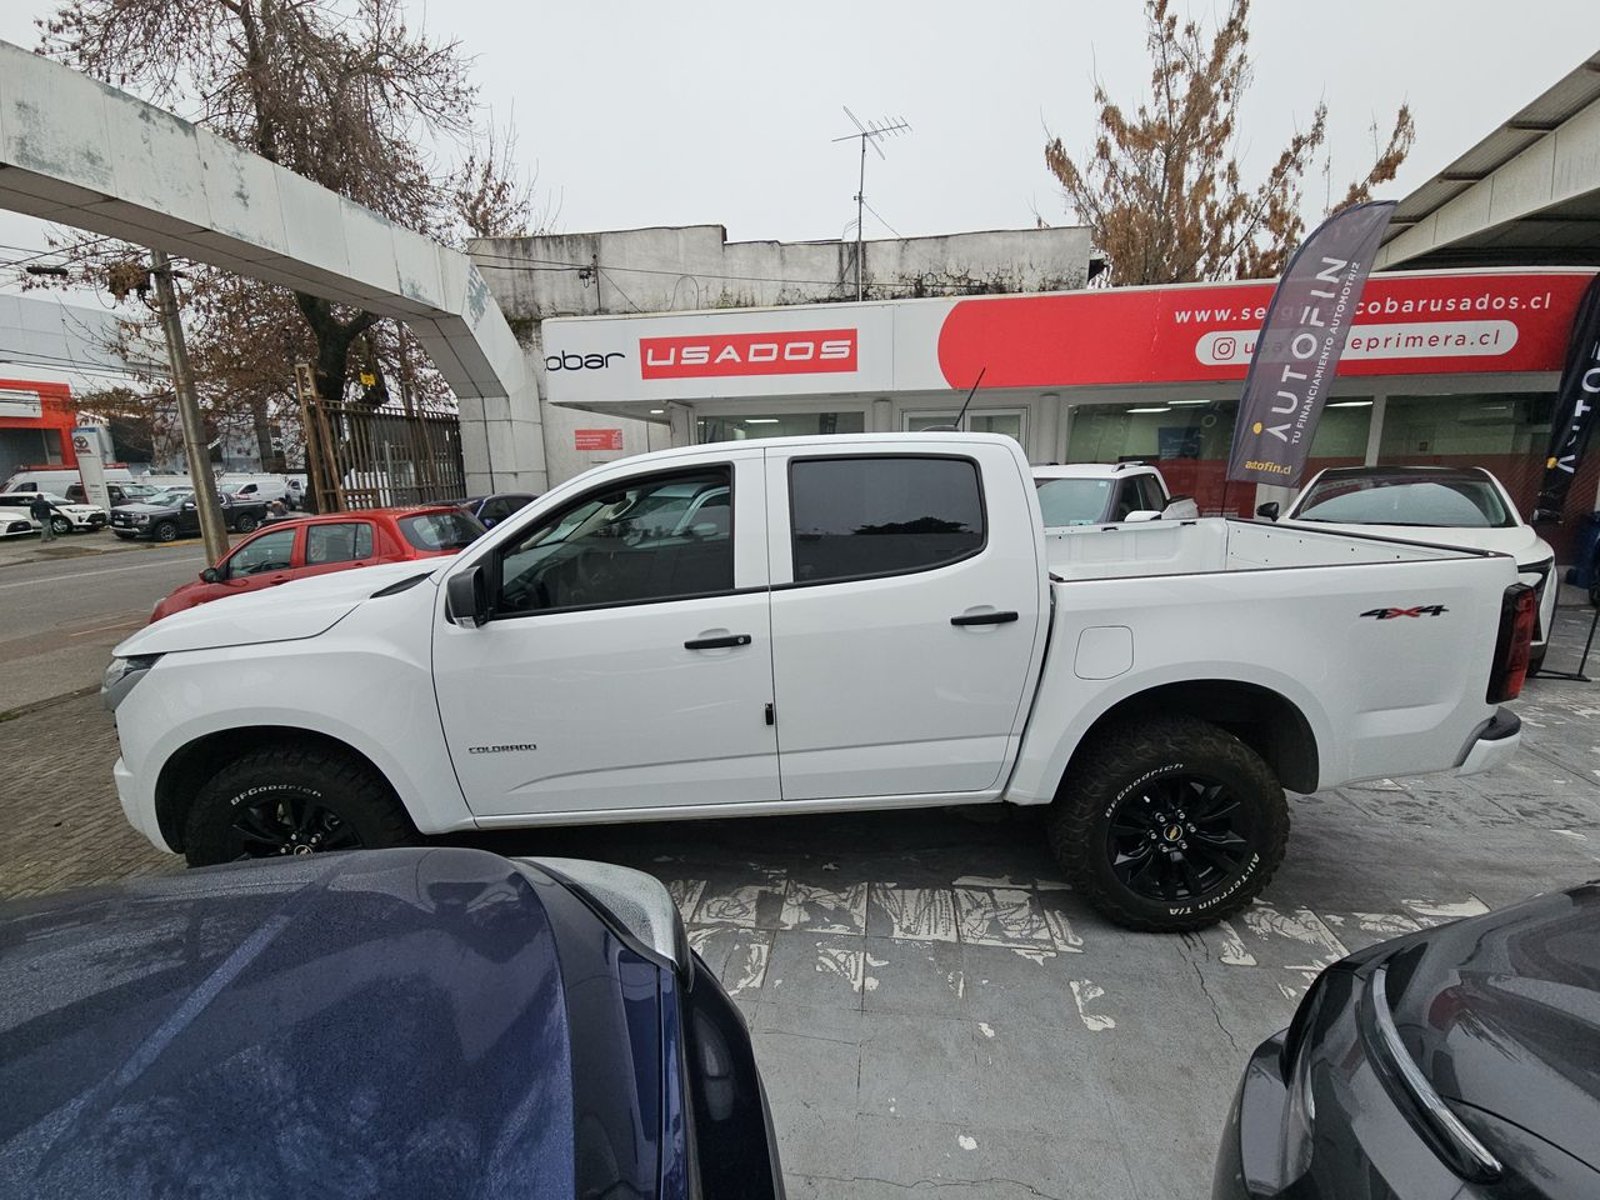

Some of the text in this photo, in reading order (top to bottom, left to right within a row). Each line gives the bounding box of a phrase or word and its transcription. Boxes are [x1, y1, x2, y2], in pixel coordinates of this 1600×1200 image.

[1174, 293, 1552, 323] www.segcobarusados.cl
[544, 340, 852, 372] obar USADOS
[1243, 329, 1501, 355] ueprimera.cl
[1266, 257, 1348, 442] AUTOFIN
[1291, 261, 1361, 444] TU FINANCIAMIENTO AUTOMOTRIZ
[468, 744, 537, 754] COLORADO
[230, 784, 322, 806] BFGoodrich
[1105, 763, 1184, 818] BFGoodrich
[1169, 852, 1260, 915] All-Terrain T/A
